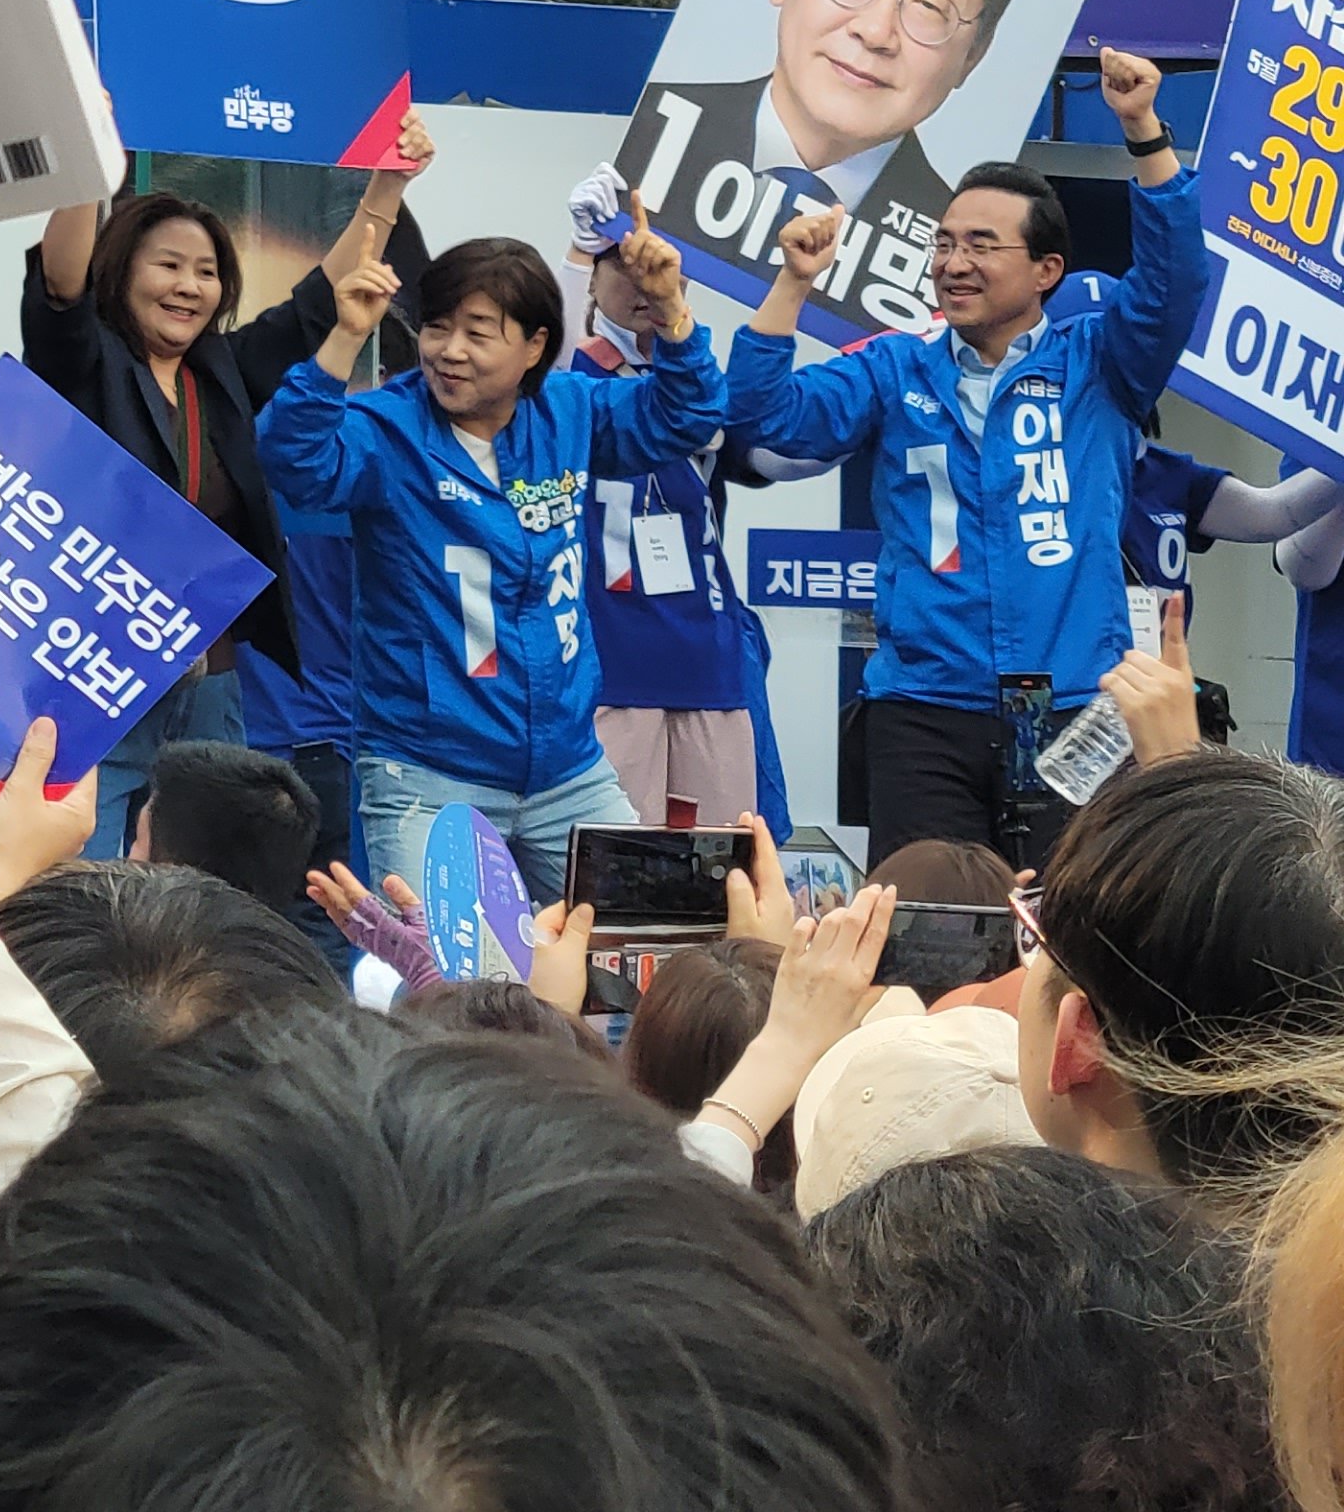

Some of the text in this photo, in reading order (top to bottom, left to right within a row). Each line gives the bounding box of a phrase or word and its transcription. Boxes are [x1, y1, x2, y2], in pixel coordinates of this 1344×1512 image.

[223, 97, 295, 134] 민주당
[1247, 49, 1281, 86] 5월
[1082, 276, 1102, 302] 1
[595, 477, 634, 592] 1
[905, 443, 961, 573] 1
[1012, 401, 1074, 567] 이재명
[49, 525, 202, 663] 민주당!
[445, 544, 498, 678] 1
[766, 559, 878, 600] 지금은
[31, 617, 149, 719] 안보!
